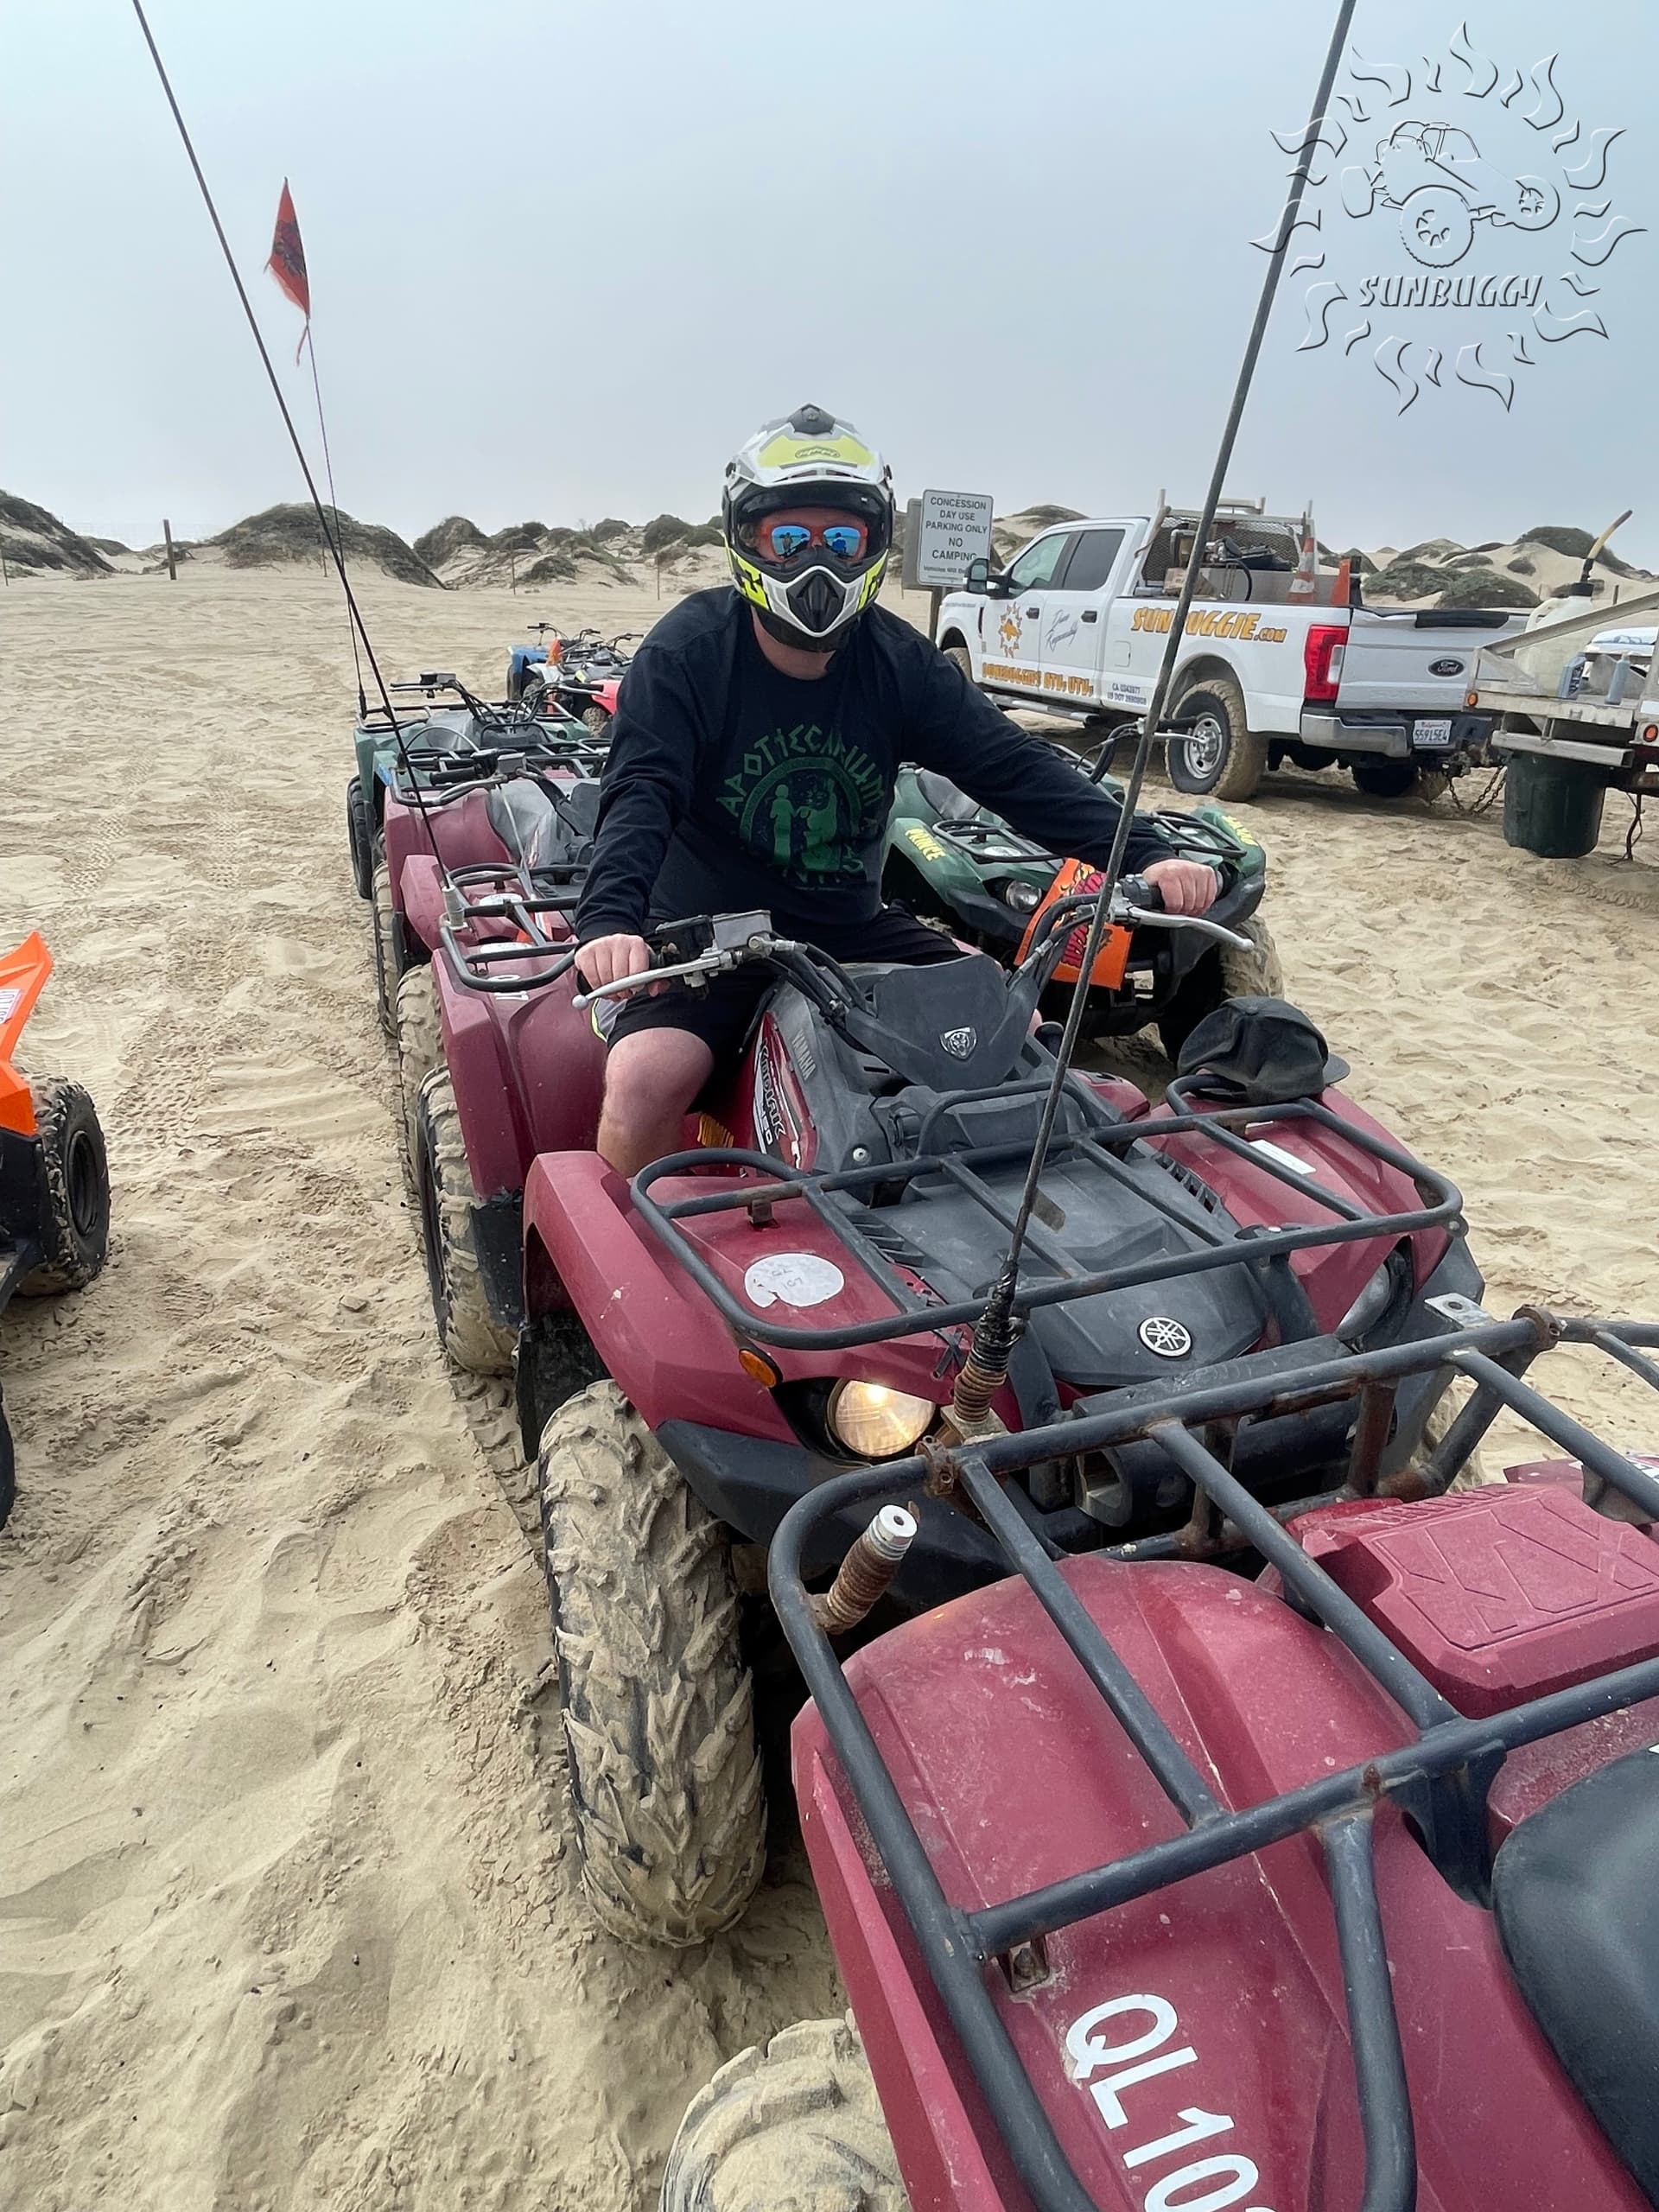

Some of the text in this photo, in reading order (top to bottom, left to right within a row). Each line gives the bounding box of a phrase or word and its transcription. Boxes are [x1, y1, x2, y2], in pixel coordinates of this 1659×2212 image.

[930, 497, 987, 511] CONCESSION
[939, 510, 976, 521] DAY USE
[925, 520, 988, 534] PARKING ONLY
[948, 537, 963, 548] NO
[791, 1029, 816, 1081] YAMAHA
